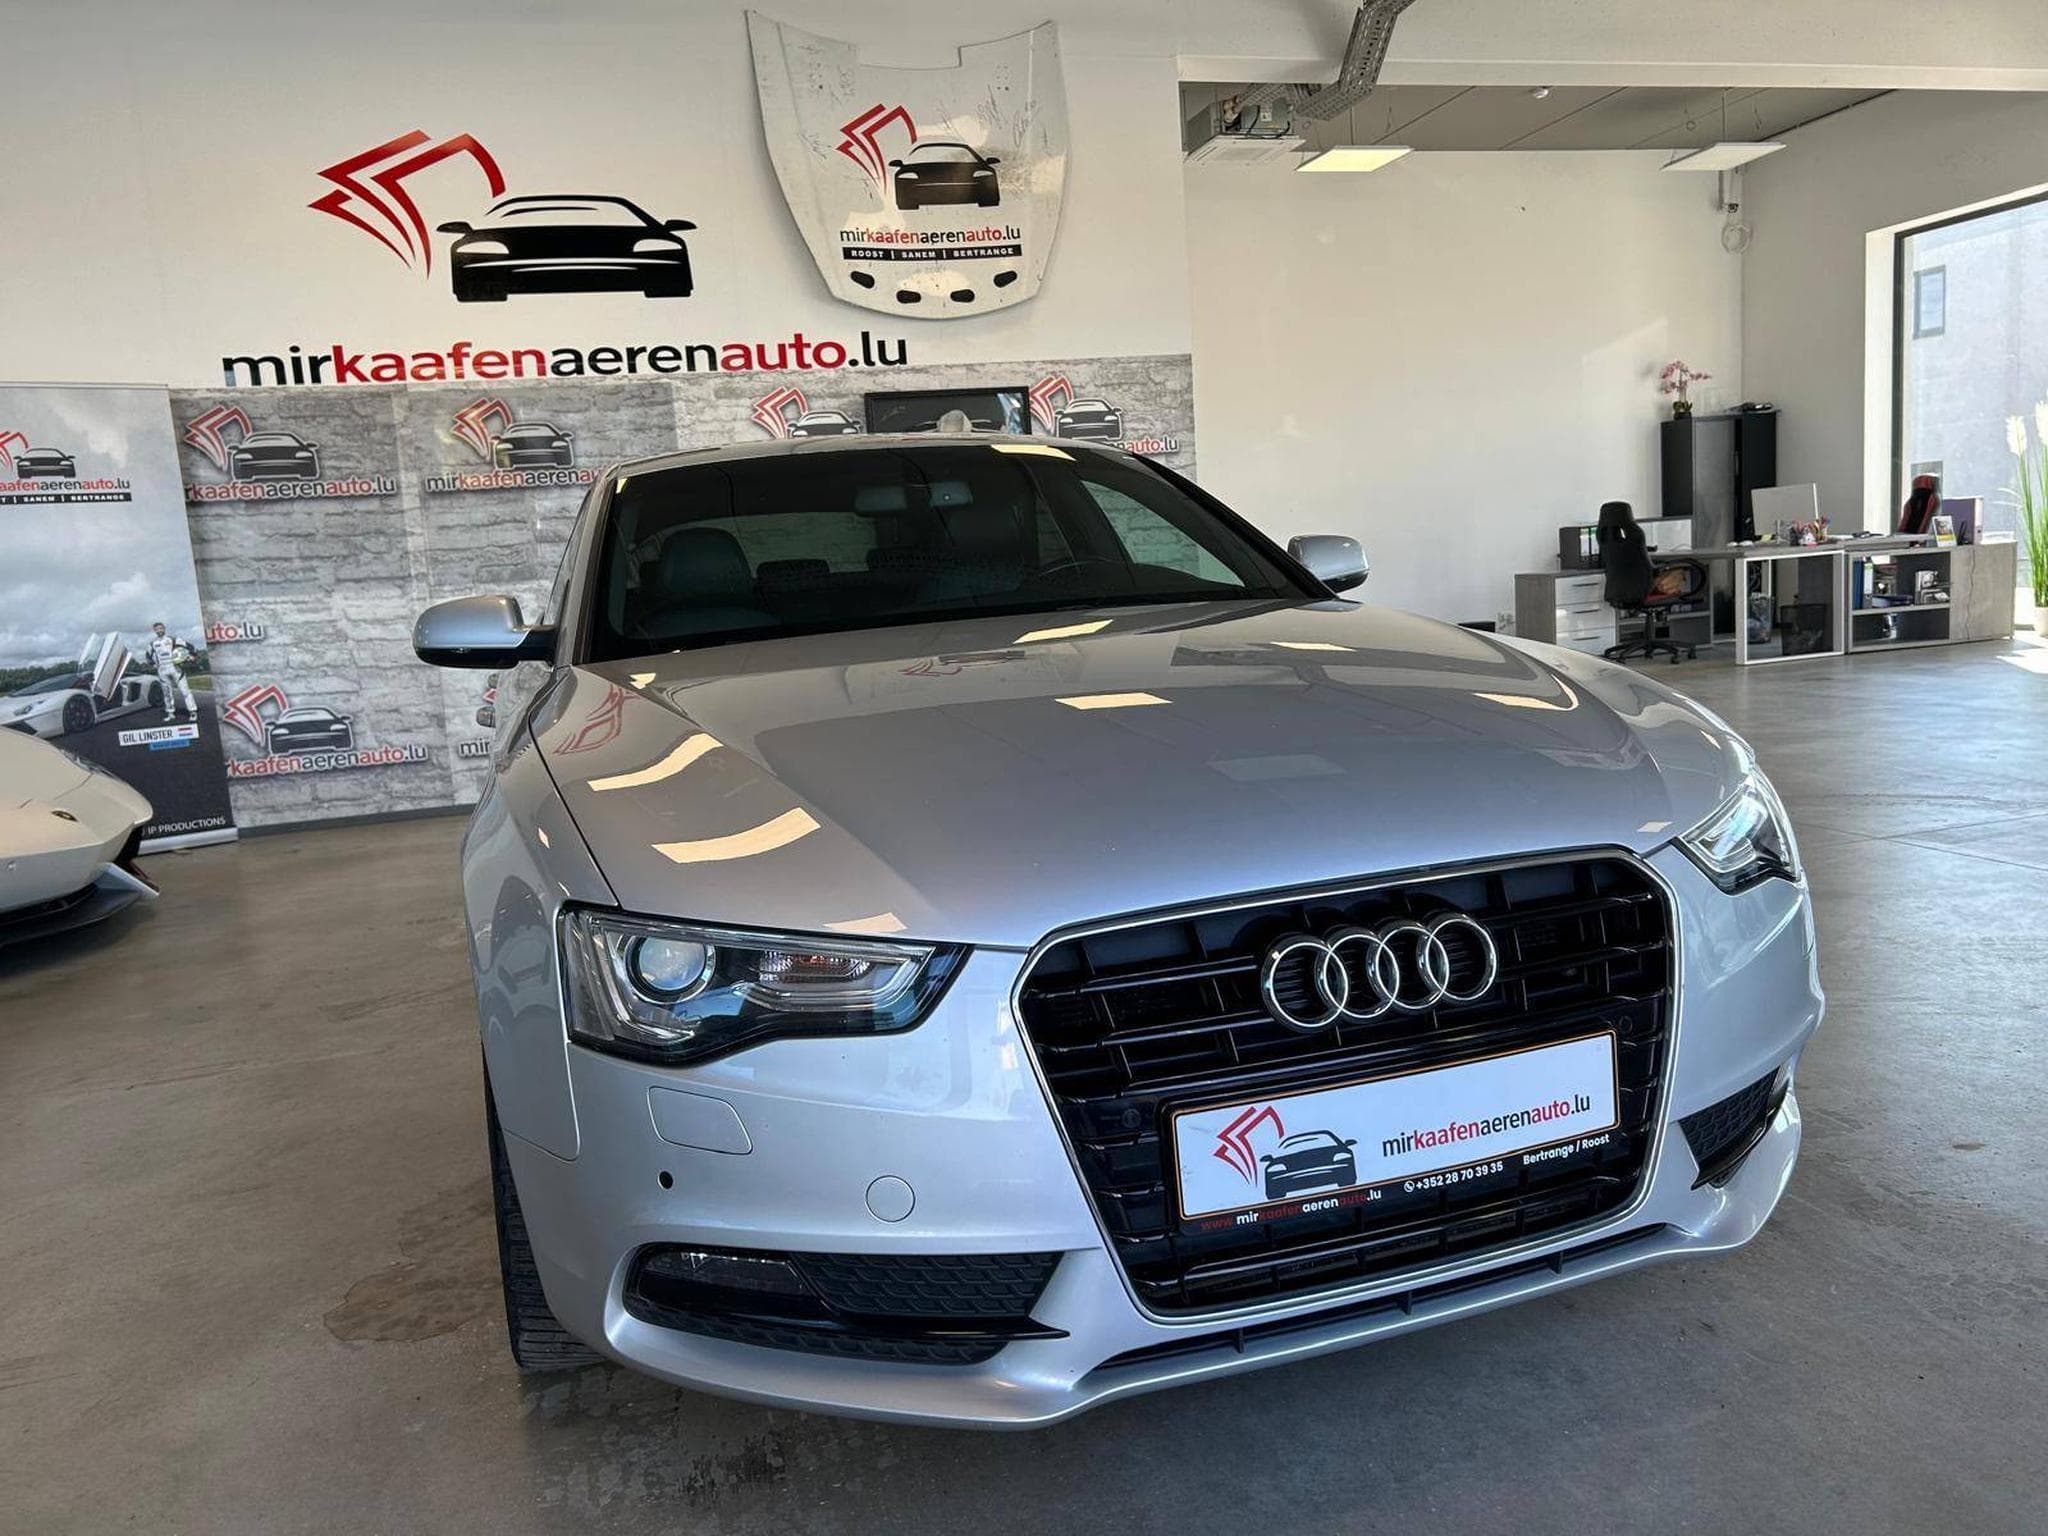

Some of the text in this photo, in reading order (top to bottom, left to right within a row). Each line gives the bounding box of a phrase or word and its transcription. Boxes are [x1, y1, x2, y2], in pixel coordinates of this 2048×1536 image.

[840, 225, 1021, 244] mirkaafenaerenauto.lu
[851, 250, 884, 258] ROOST
[901, 250, 936, 259] SANEM
[953, 247, 1014, 258] BERTRANGE
[222, 331, 907, 387] mirkaafenaerenauto.lu
[122, 729, 173, 744] GIL LINSTER
[158, 816, 226, 833] PRODUCTIONS
[1382, 1094, 1590, 1157] mirkaafenaerenauto.lu
[1523, 1145, 1575, 1165] Bertrange
[1582, 1134, 1610, 1149] Roost
[1416, 1161, 1503, 1190] +352 28 70 39 35
